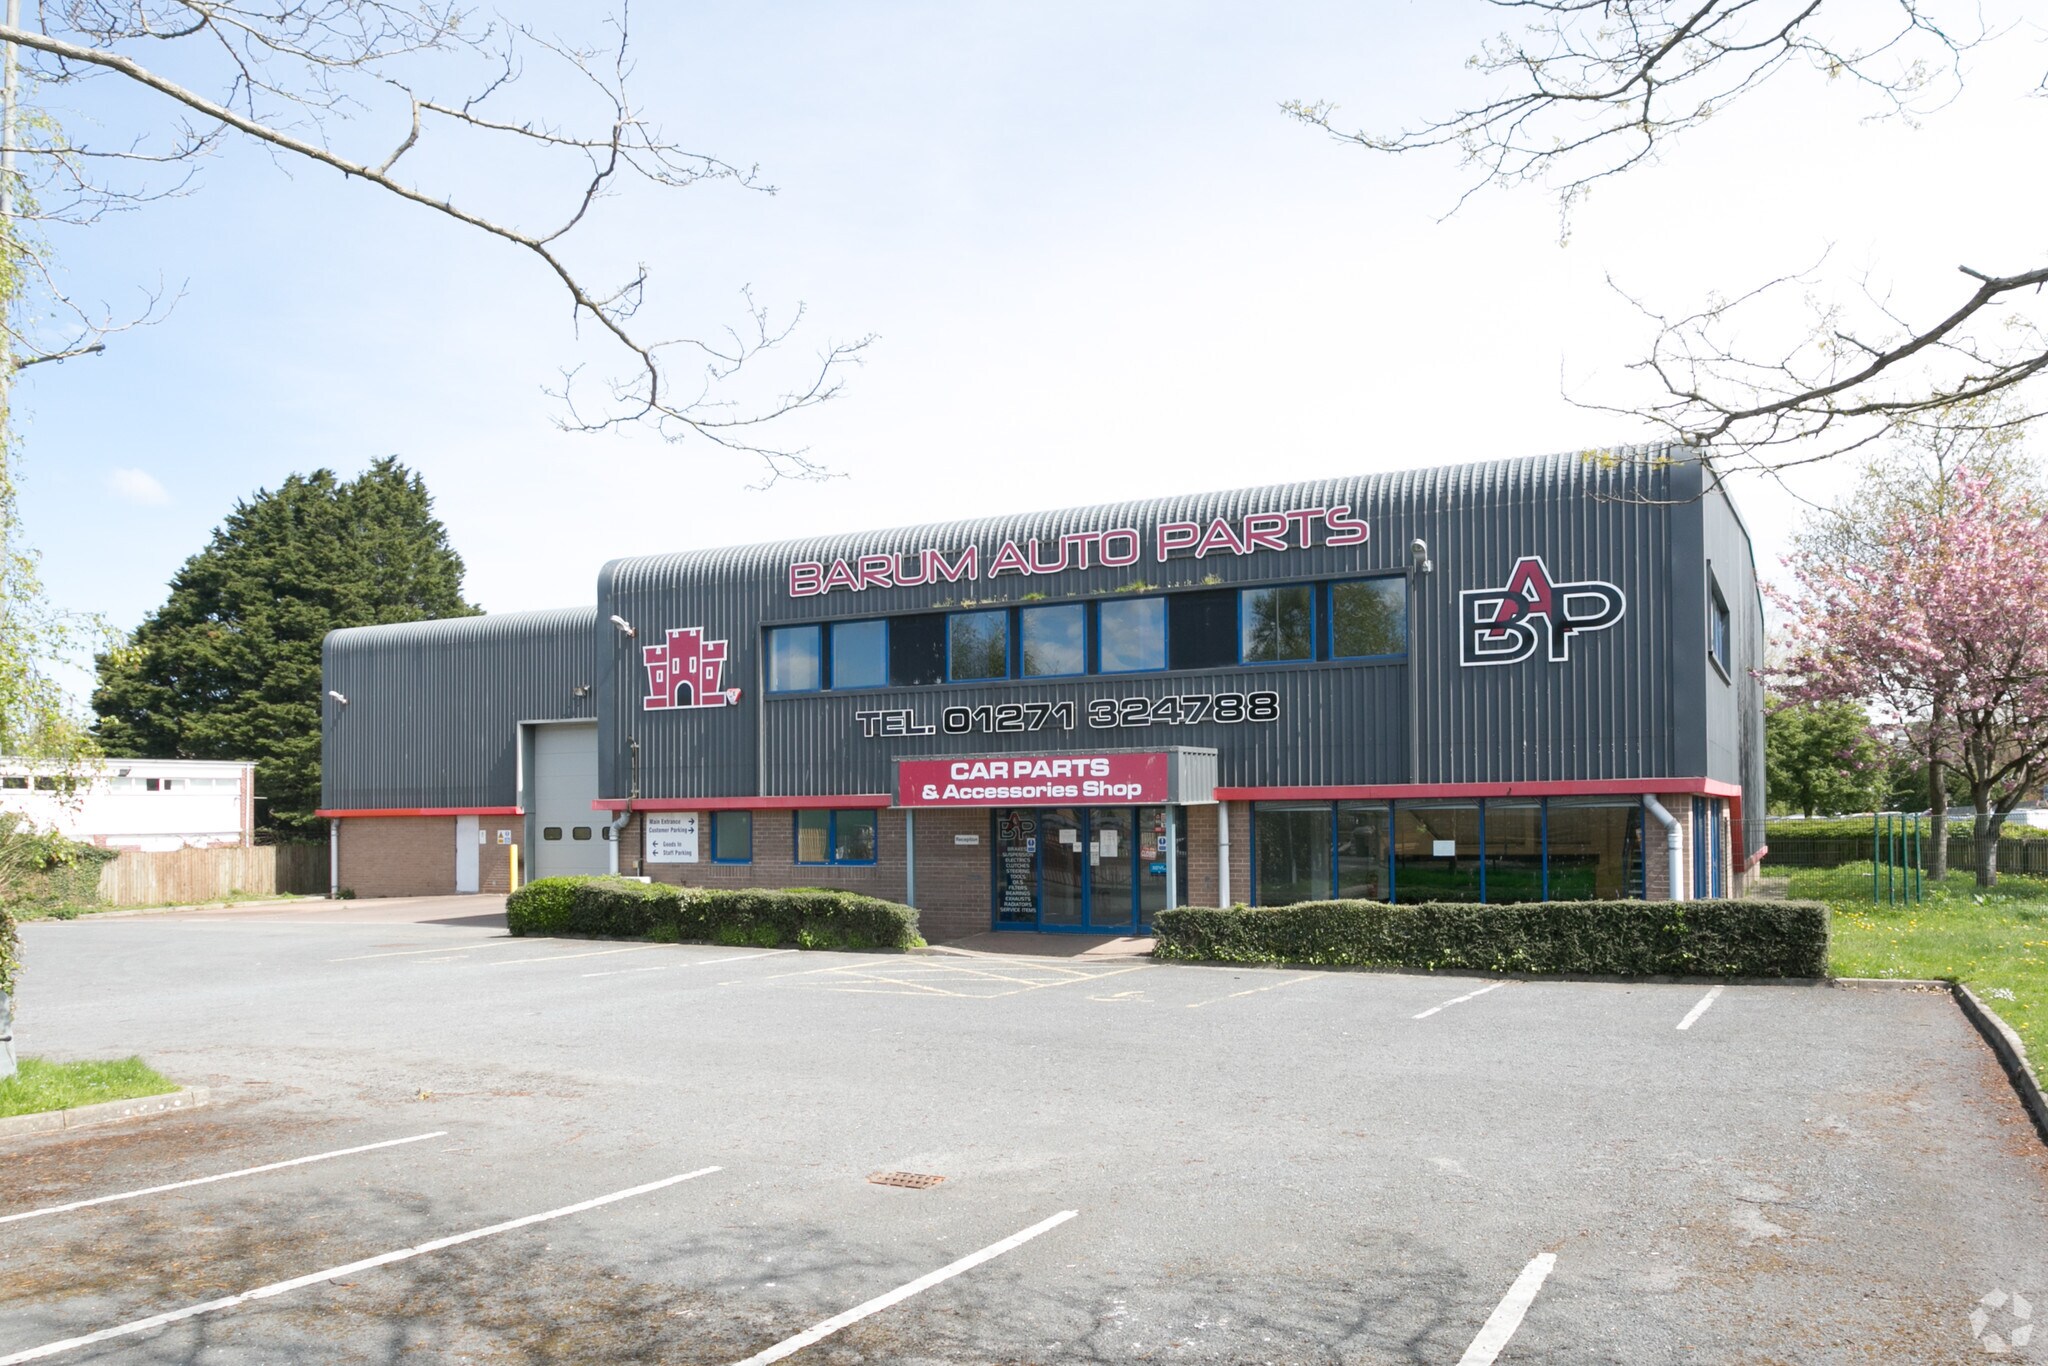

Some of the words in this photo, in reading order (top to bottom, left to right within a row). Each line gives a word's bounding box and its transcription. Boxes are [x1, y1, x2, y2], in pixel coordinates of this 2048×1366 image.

[789, 545, 978, 597] BARUM
[988, 528, 1140, 579] AUTO
[1157, 505, 1370, 562] PARTS
[856, 709, 936, 737] TEL.
[943, 701, 1074, 734] 01271
[1088, 691, 1280, 729] 324788
[951, 762, 1008, 780] CAR
[1013, 758, 1110, 779] PARTS
[922, 784, 939, 800] &
[942, 782, 1078, 799] Accessories
[1082, 780, 1142, 800] Shop
